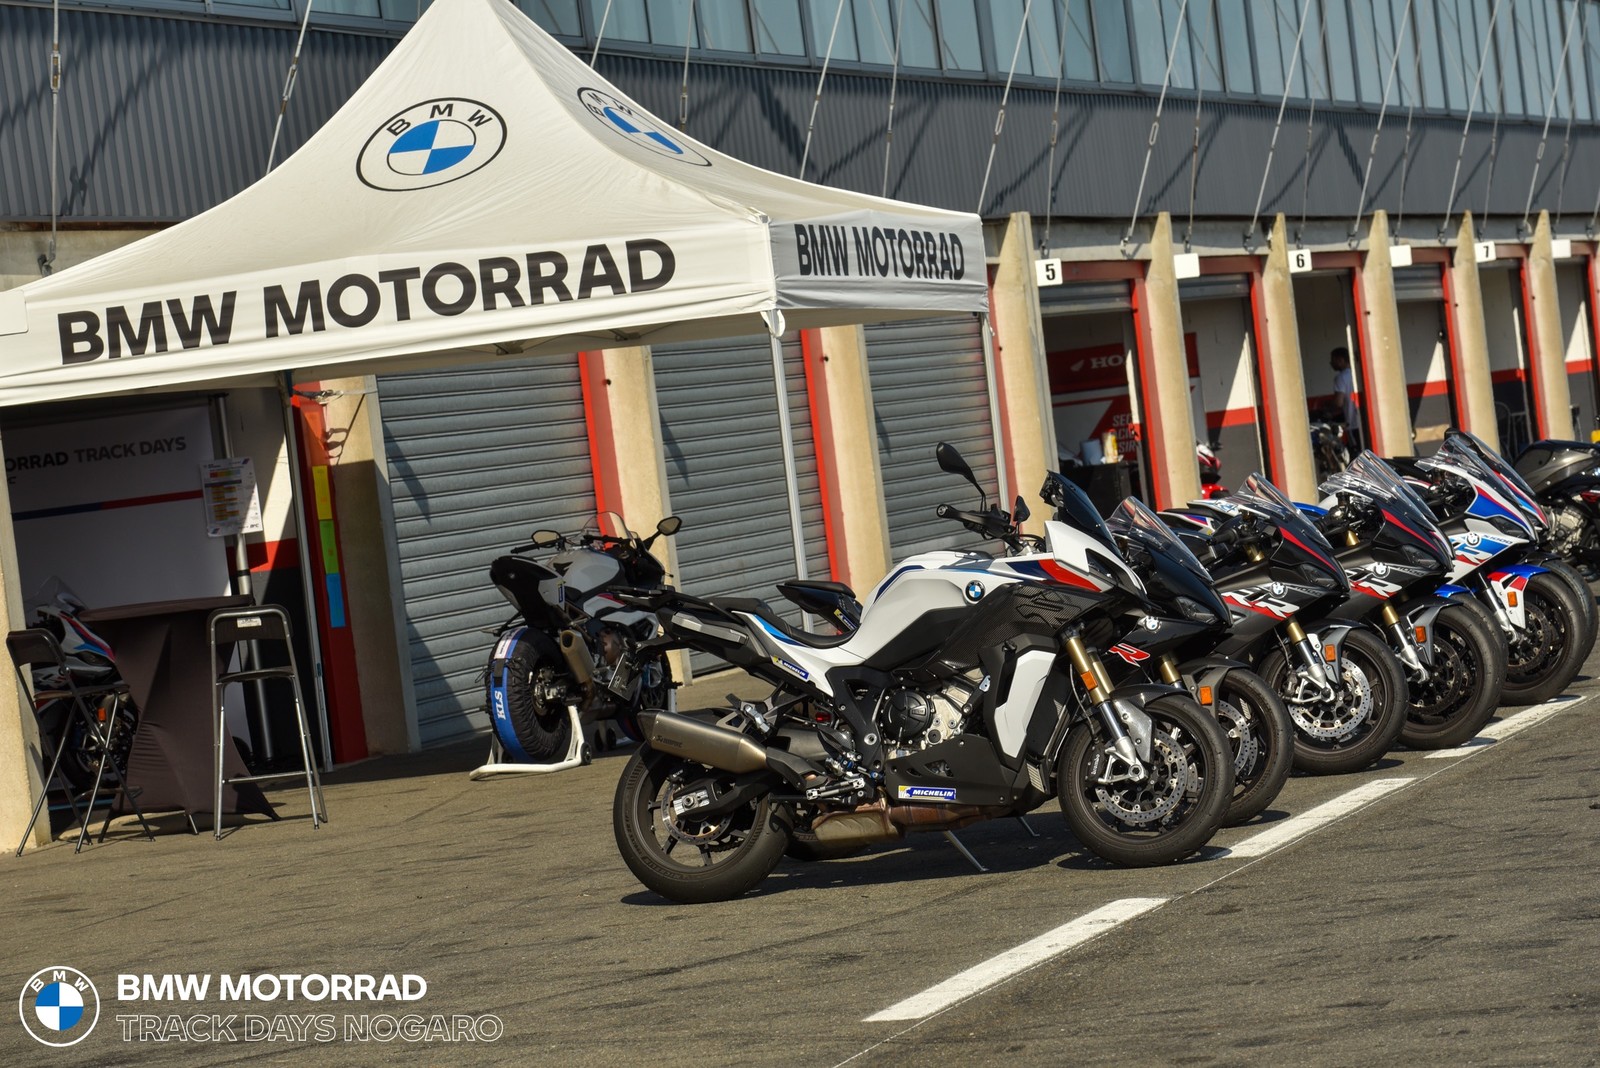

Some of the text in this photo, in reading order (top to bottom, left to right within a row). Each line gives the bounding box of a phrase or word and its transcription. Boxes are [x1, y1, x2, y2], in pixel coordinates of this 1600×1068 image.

[386, 103, 493, 137] BMW
[794, 223, 965, 280] BMW MOTORRAD
[1296, 253, 1305, 268] 6
[1045, 263, 1056, 281] 5
[58, 238, 676, 365] BMW MOTORRAD
[1090, 354, 1125, 369] HO
[74, 442, 136, 463] TRACK
[139, 436, 187, 456] DAYS
[783, 662, 807, 678] MICHELIN
[494, 690, 506, 720] KLS
[912, 789, 954, 797] MICHELIN
